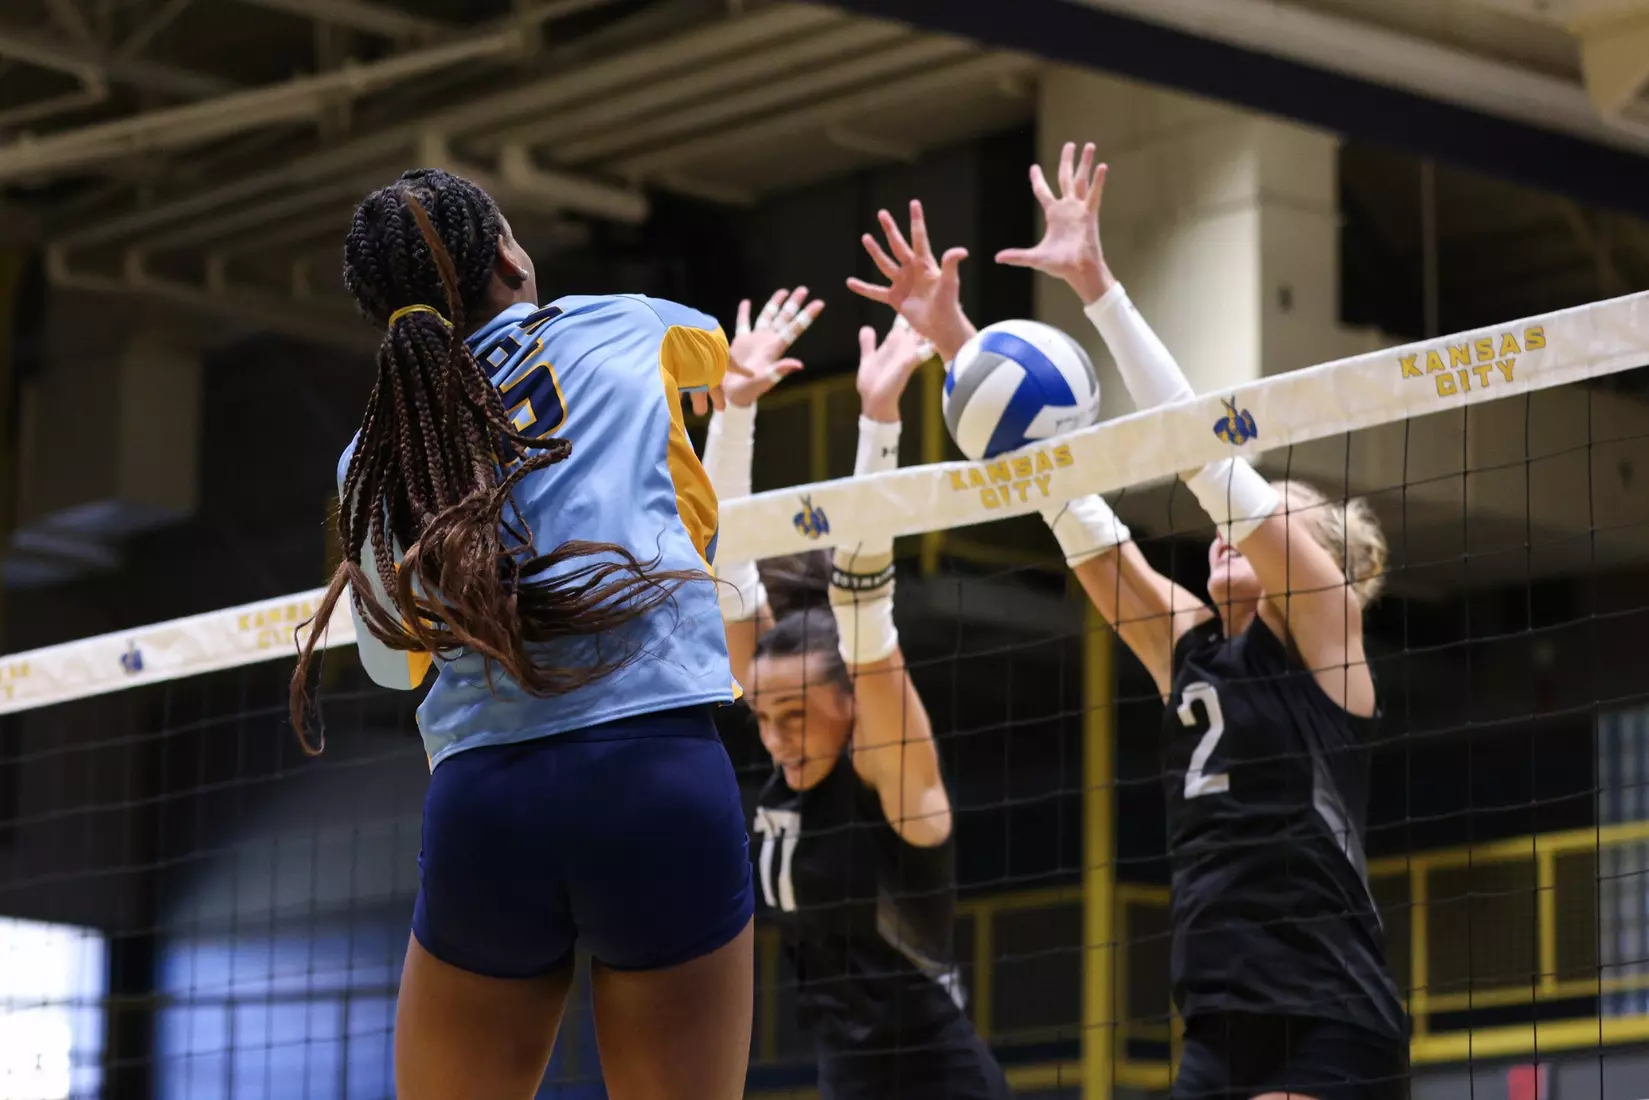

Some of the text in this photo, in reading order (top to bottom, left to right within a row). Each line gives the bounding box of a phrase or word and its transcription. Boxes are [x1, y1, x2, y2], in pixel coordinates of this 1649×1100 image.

[1399, 326, 1546, 379] KANSAS
[1435, 358, 1516, 397] CITY
[950, 444, 1074, 491] KANSAS
[980, 474, 1052, 510] CITY
[1177, 681, 1229, 799] 2
